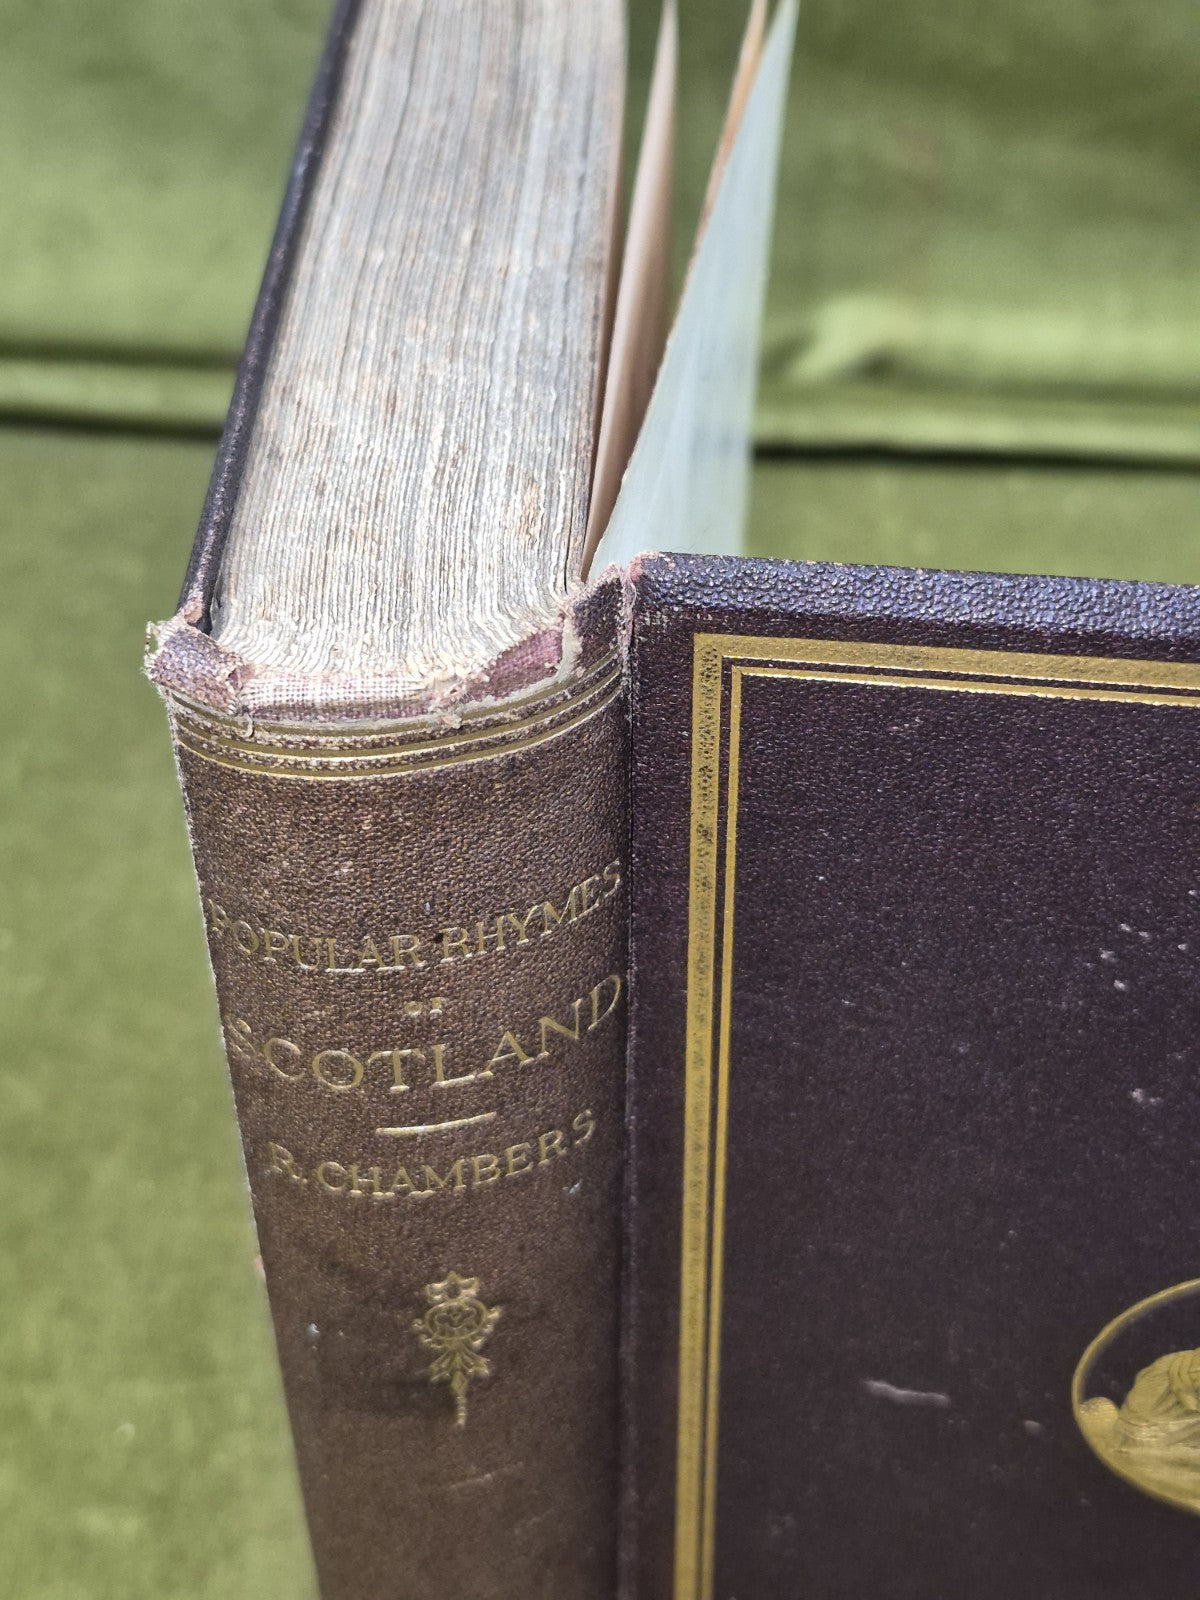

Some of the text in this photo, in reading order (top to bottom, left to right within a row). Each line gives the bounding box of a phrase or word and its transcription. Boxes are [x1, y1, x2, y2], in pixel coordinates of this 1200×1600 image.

[207, 858, 621, 973] POPULAR RHYMES
[225, 974, 621, 1092] SCOTLAND
[312, 1108, 596, 1198] CHAMBERS
